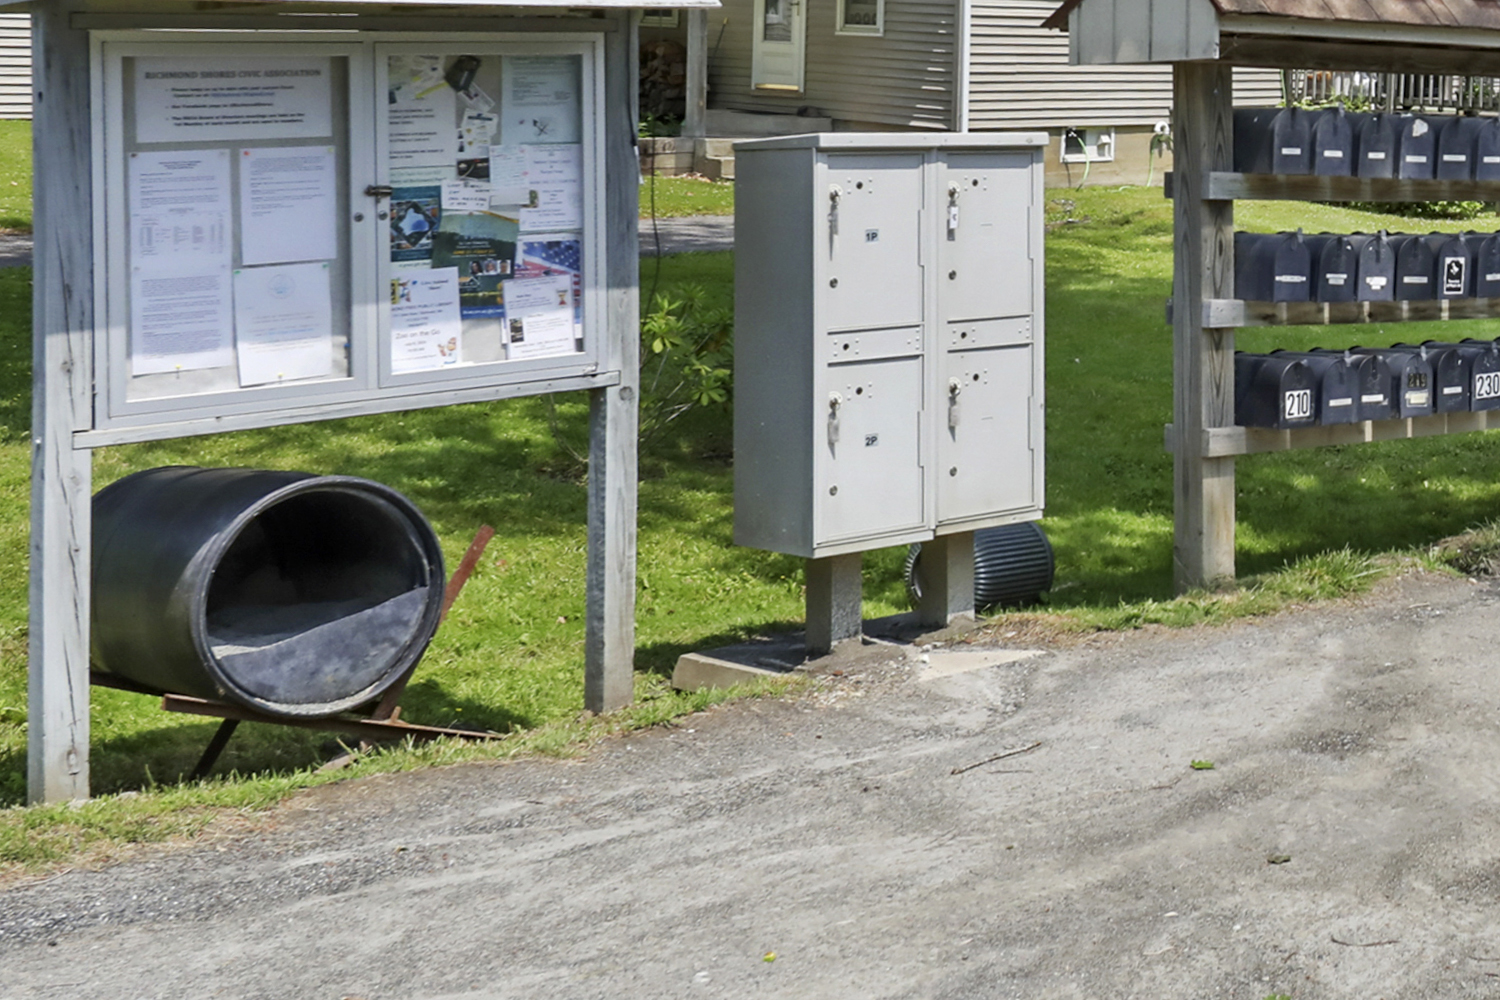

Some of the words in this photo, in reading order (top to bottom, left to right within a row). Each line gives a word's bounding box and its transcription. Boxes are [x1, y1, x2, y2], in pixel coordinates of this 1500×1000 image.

[145, 71, 198, 80] RICHMOND
[238, 70, 262, 78] CIVIC
[264, 69, 321, 78] ASSOCIATION
[866, 232, 878, 241] 1P
[1477, 374, 1500, 397] 230
[1287, 391, 1310, 416] 210
[865, 436, 878, 447] 2P
